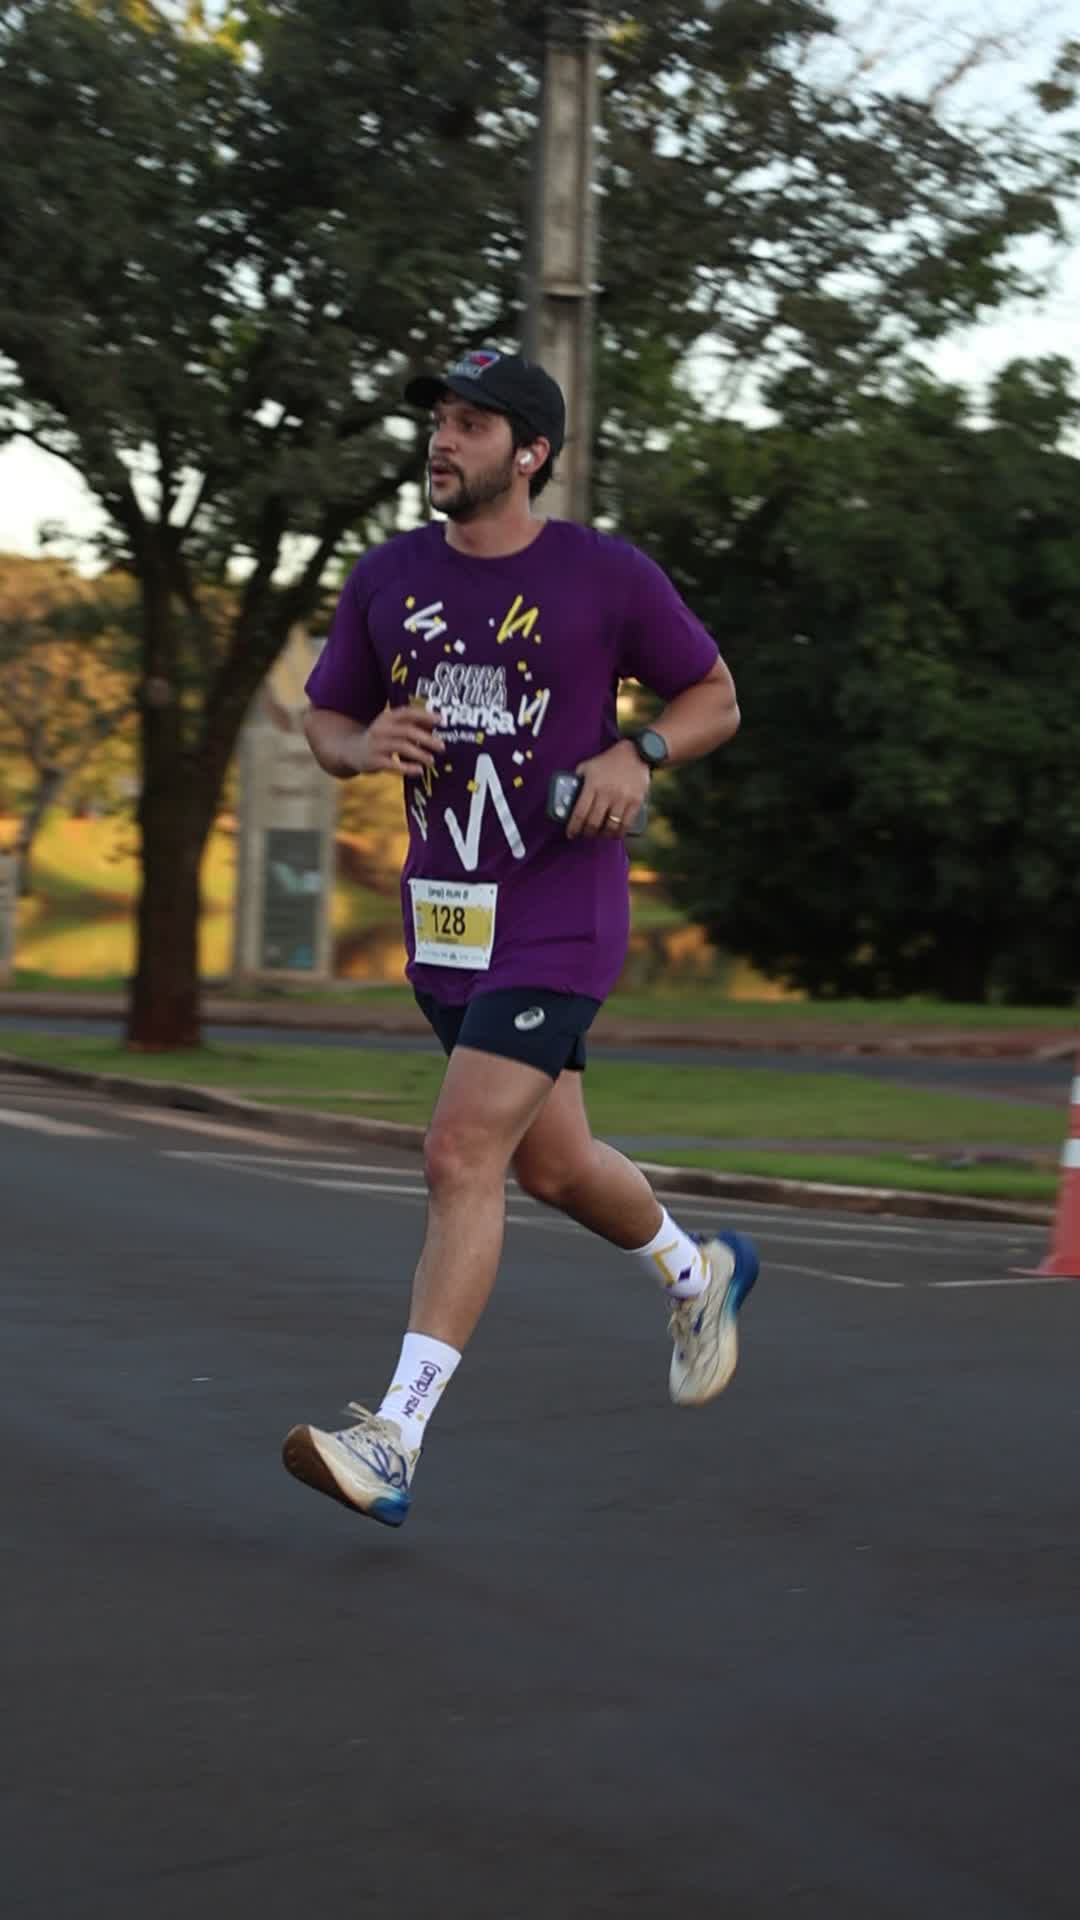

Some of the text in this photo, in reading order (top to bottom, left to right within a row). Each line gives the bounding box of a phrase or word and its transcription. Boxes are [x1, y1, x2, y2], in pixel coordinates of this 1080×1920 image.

[431, 903, 466, 937] 128
[402, 1360, 442, 1418] (amp) RUN
